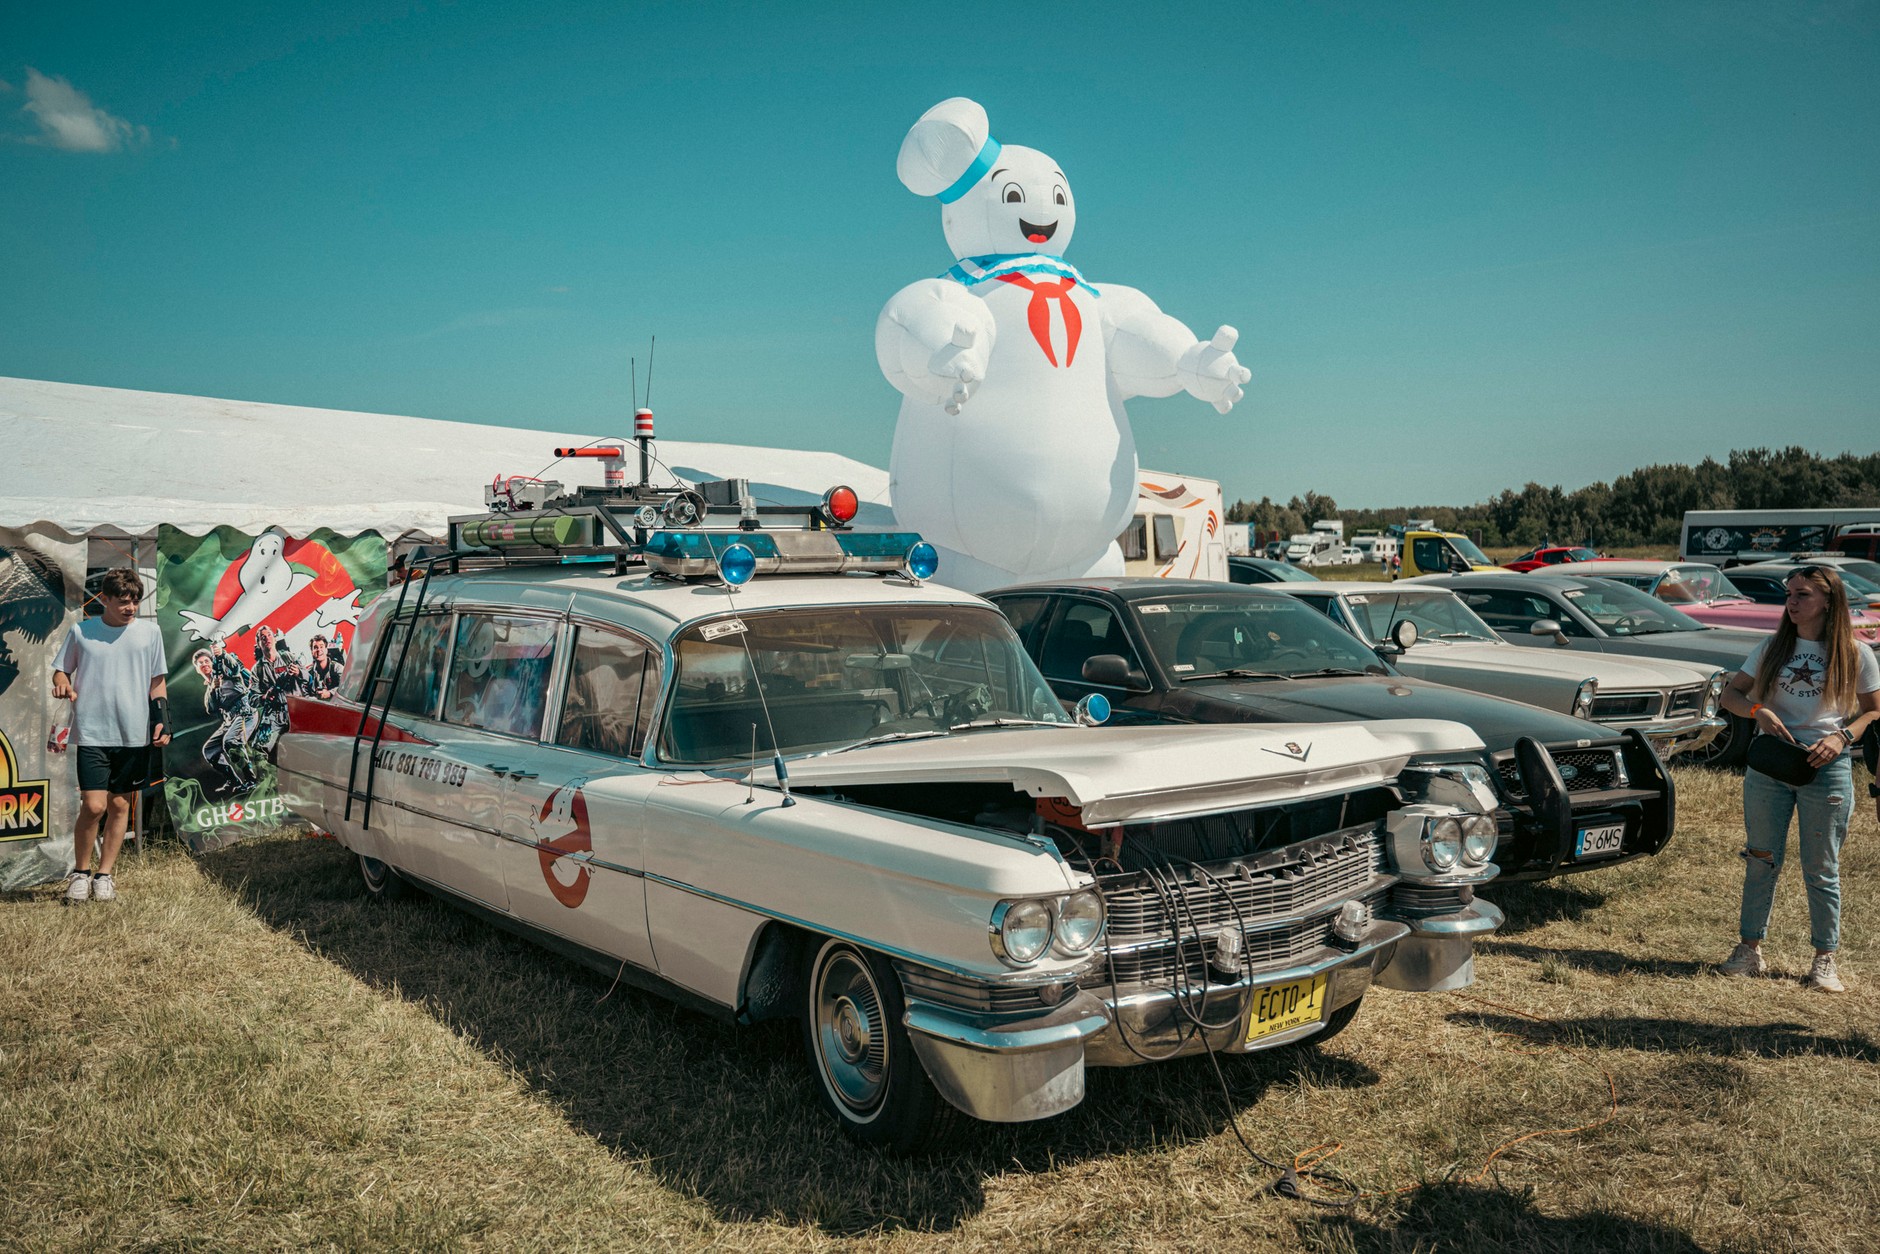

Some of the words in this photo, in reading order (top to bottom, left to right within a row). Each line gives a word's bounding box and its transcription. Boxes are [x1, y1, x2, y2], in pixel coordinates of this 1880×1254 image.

[1779, 681, 1795, 696] ALL
[373, 747, 396, 771] ALL
[396, 753, 418, 776] 881
[418, 757, 442, 781] 789
[442, 762, 468, 787] 989
[1583, 831, 1593, 851] S
[1595, 828, 1622, 849] 6MS
[1285, 1017, 1301, 1026] YORK
